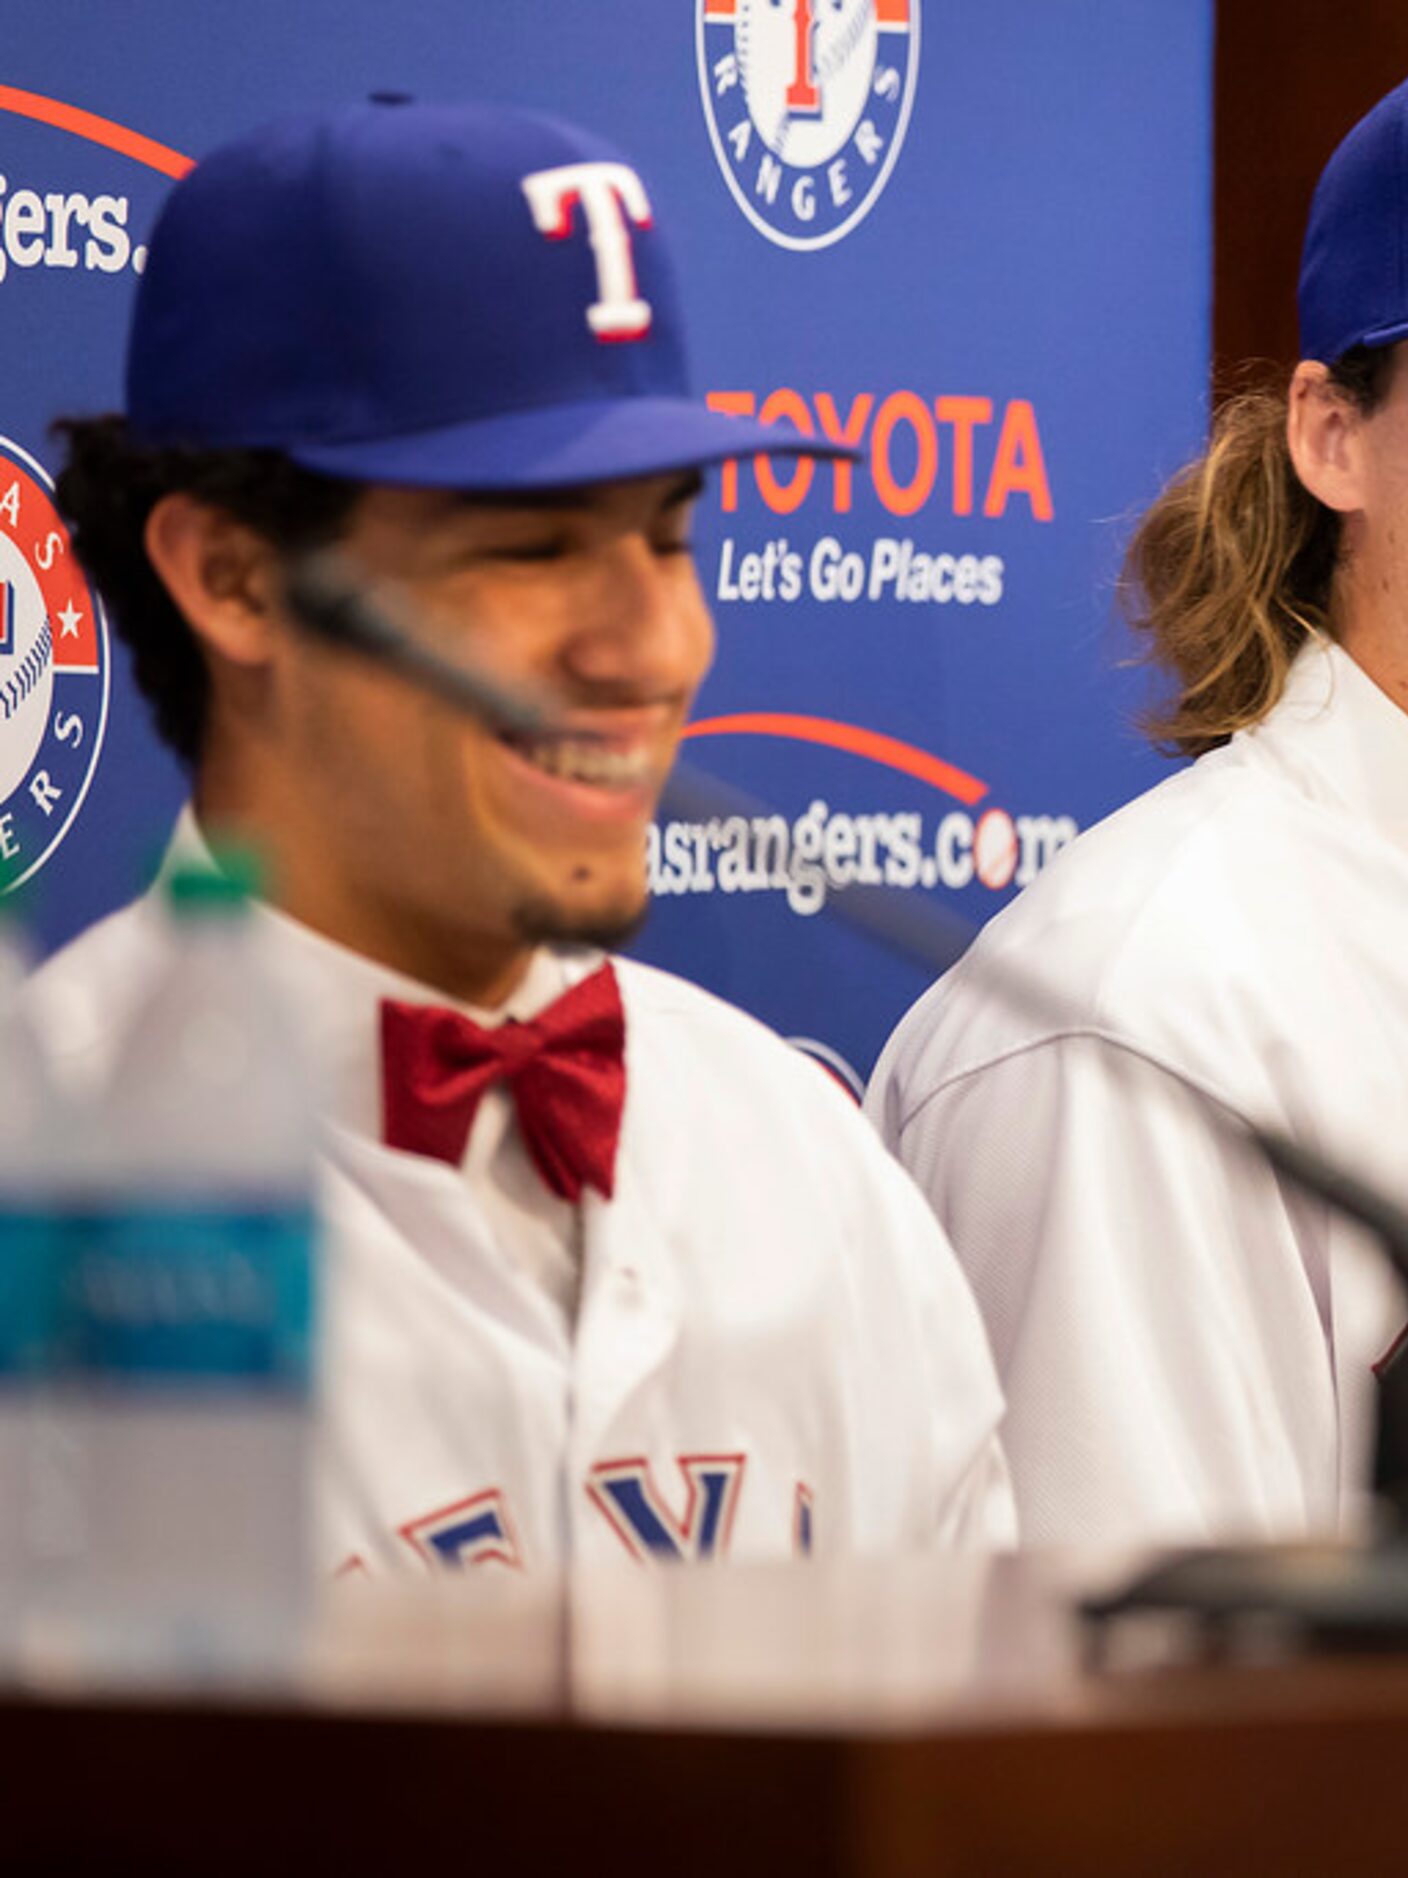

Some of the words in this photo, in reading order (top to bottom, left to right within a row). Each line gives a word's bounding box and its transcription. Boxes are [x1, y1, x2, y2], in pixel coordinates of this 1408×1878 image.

[714, 52, 902, 222] RANGERS
[521, 162, 654, 344] T
[706, 388, 1054, 522] TOYOTA
[717, 538, 803, 602] Let's
[809, 536, 865, 602] Go
[868, 538, 1005, 606] Places
